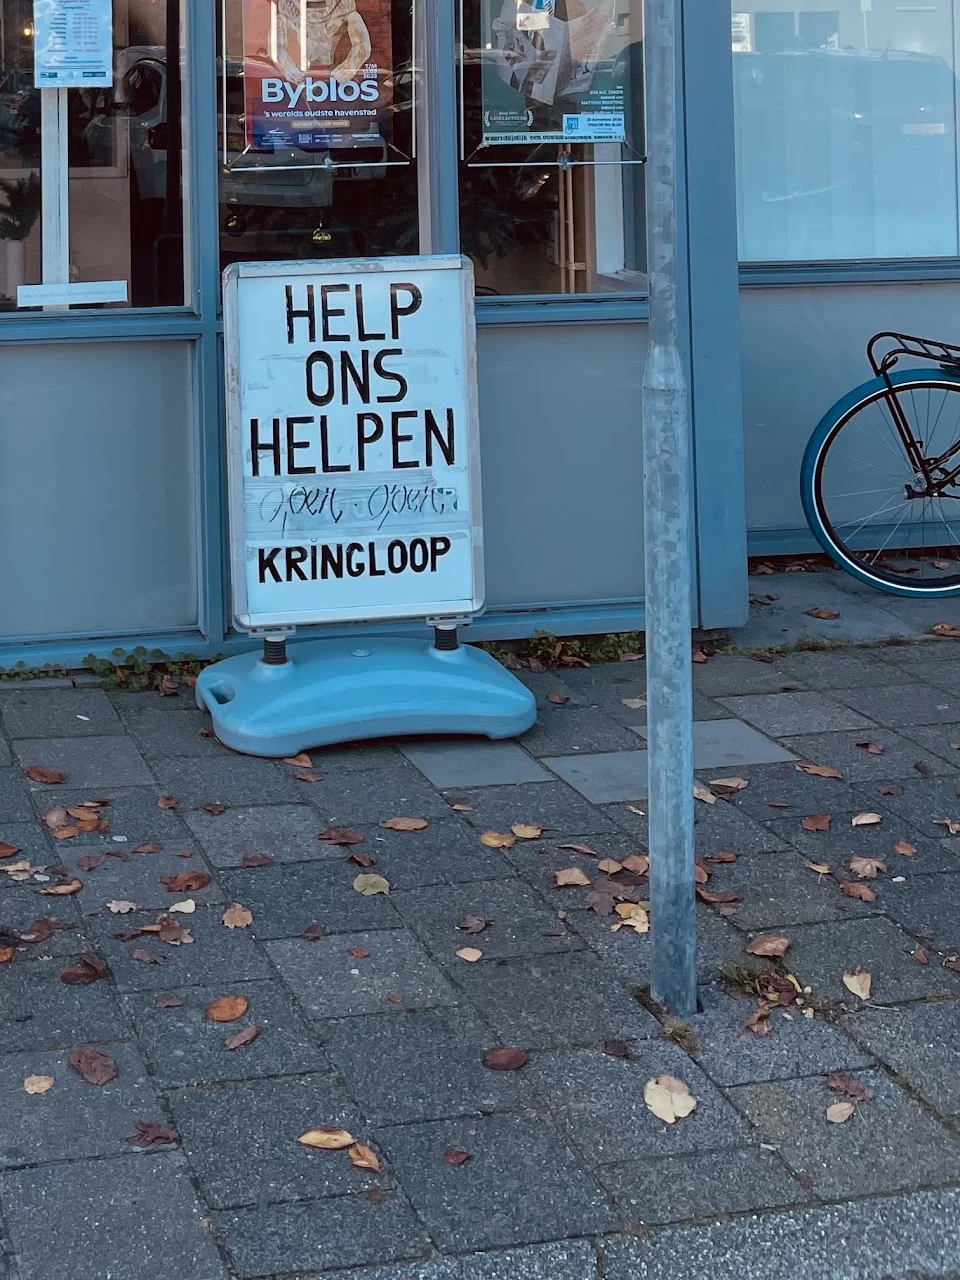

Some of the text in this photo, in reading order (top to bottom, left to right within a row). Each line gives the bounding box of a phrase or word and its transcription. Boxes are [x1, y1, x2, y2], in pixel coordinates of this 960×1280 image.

[262, 77, 379, 108] Byblos
[271, 110, 303, 118] werelds
[304, 109, 333, 117] oudste
[334, 109, 377, 117] havenstad
[285, 282, 423, 343] HELP
[305, 349, 407, 406] ONS
[251, 408, 455, 477] HELPEN
[258, 536, 451, 584] KRINGLOOP
